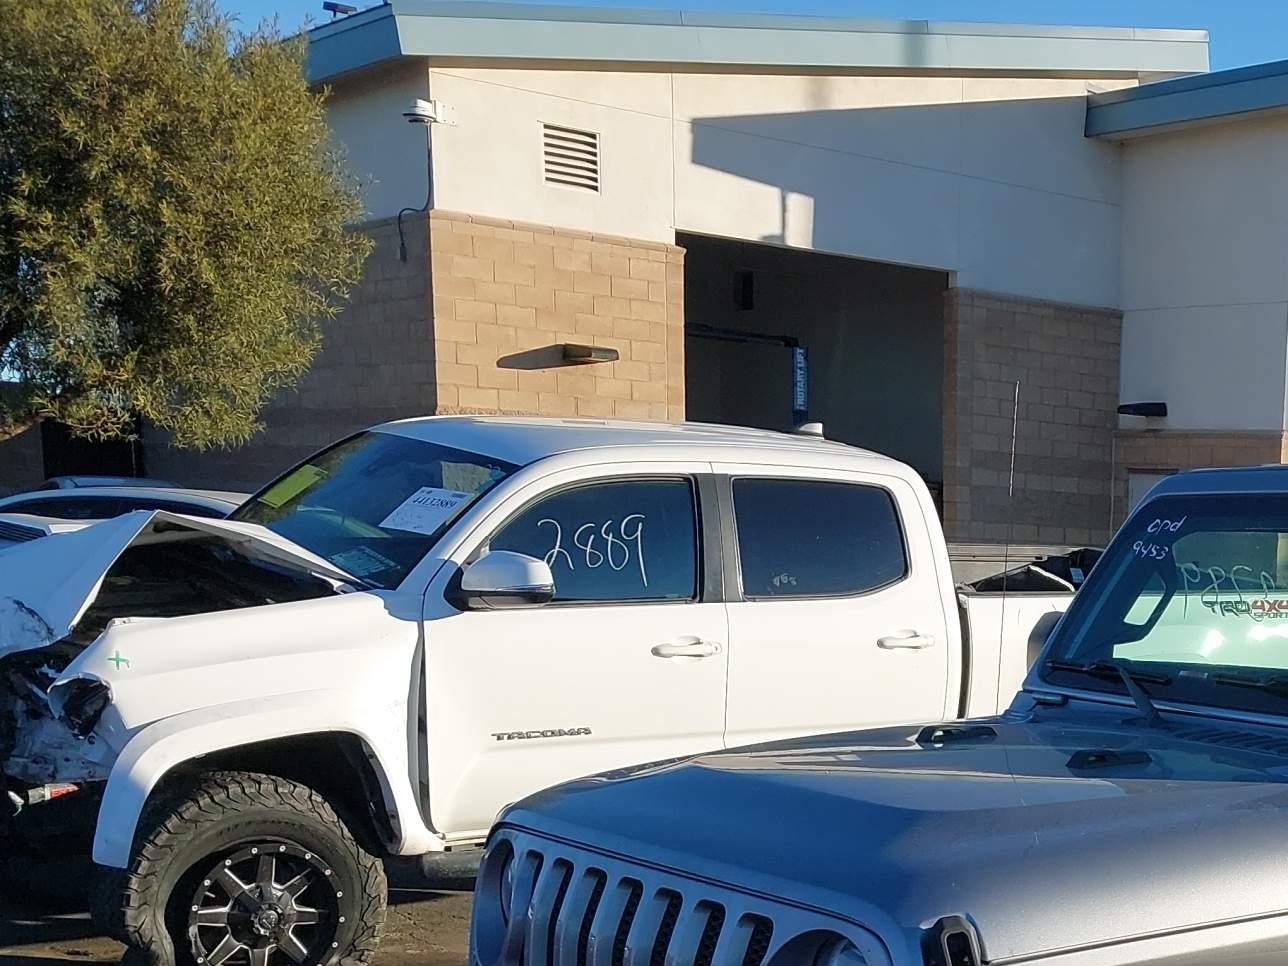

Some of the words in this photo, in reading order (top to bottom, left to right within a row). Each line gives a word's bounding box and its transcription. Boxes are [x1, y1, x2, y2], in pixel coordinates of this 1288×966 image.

[537, 514, 648, 588] 2889
[1201, 600, 1251, 616] TRD
[491, 727, 592, 741] TACOMA
